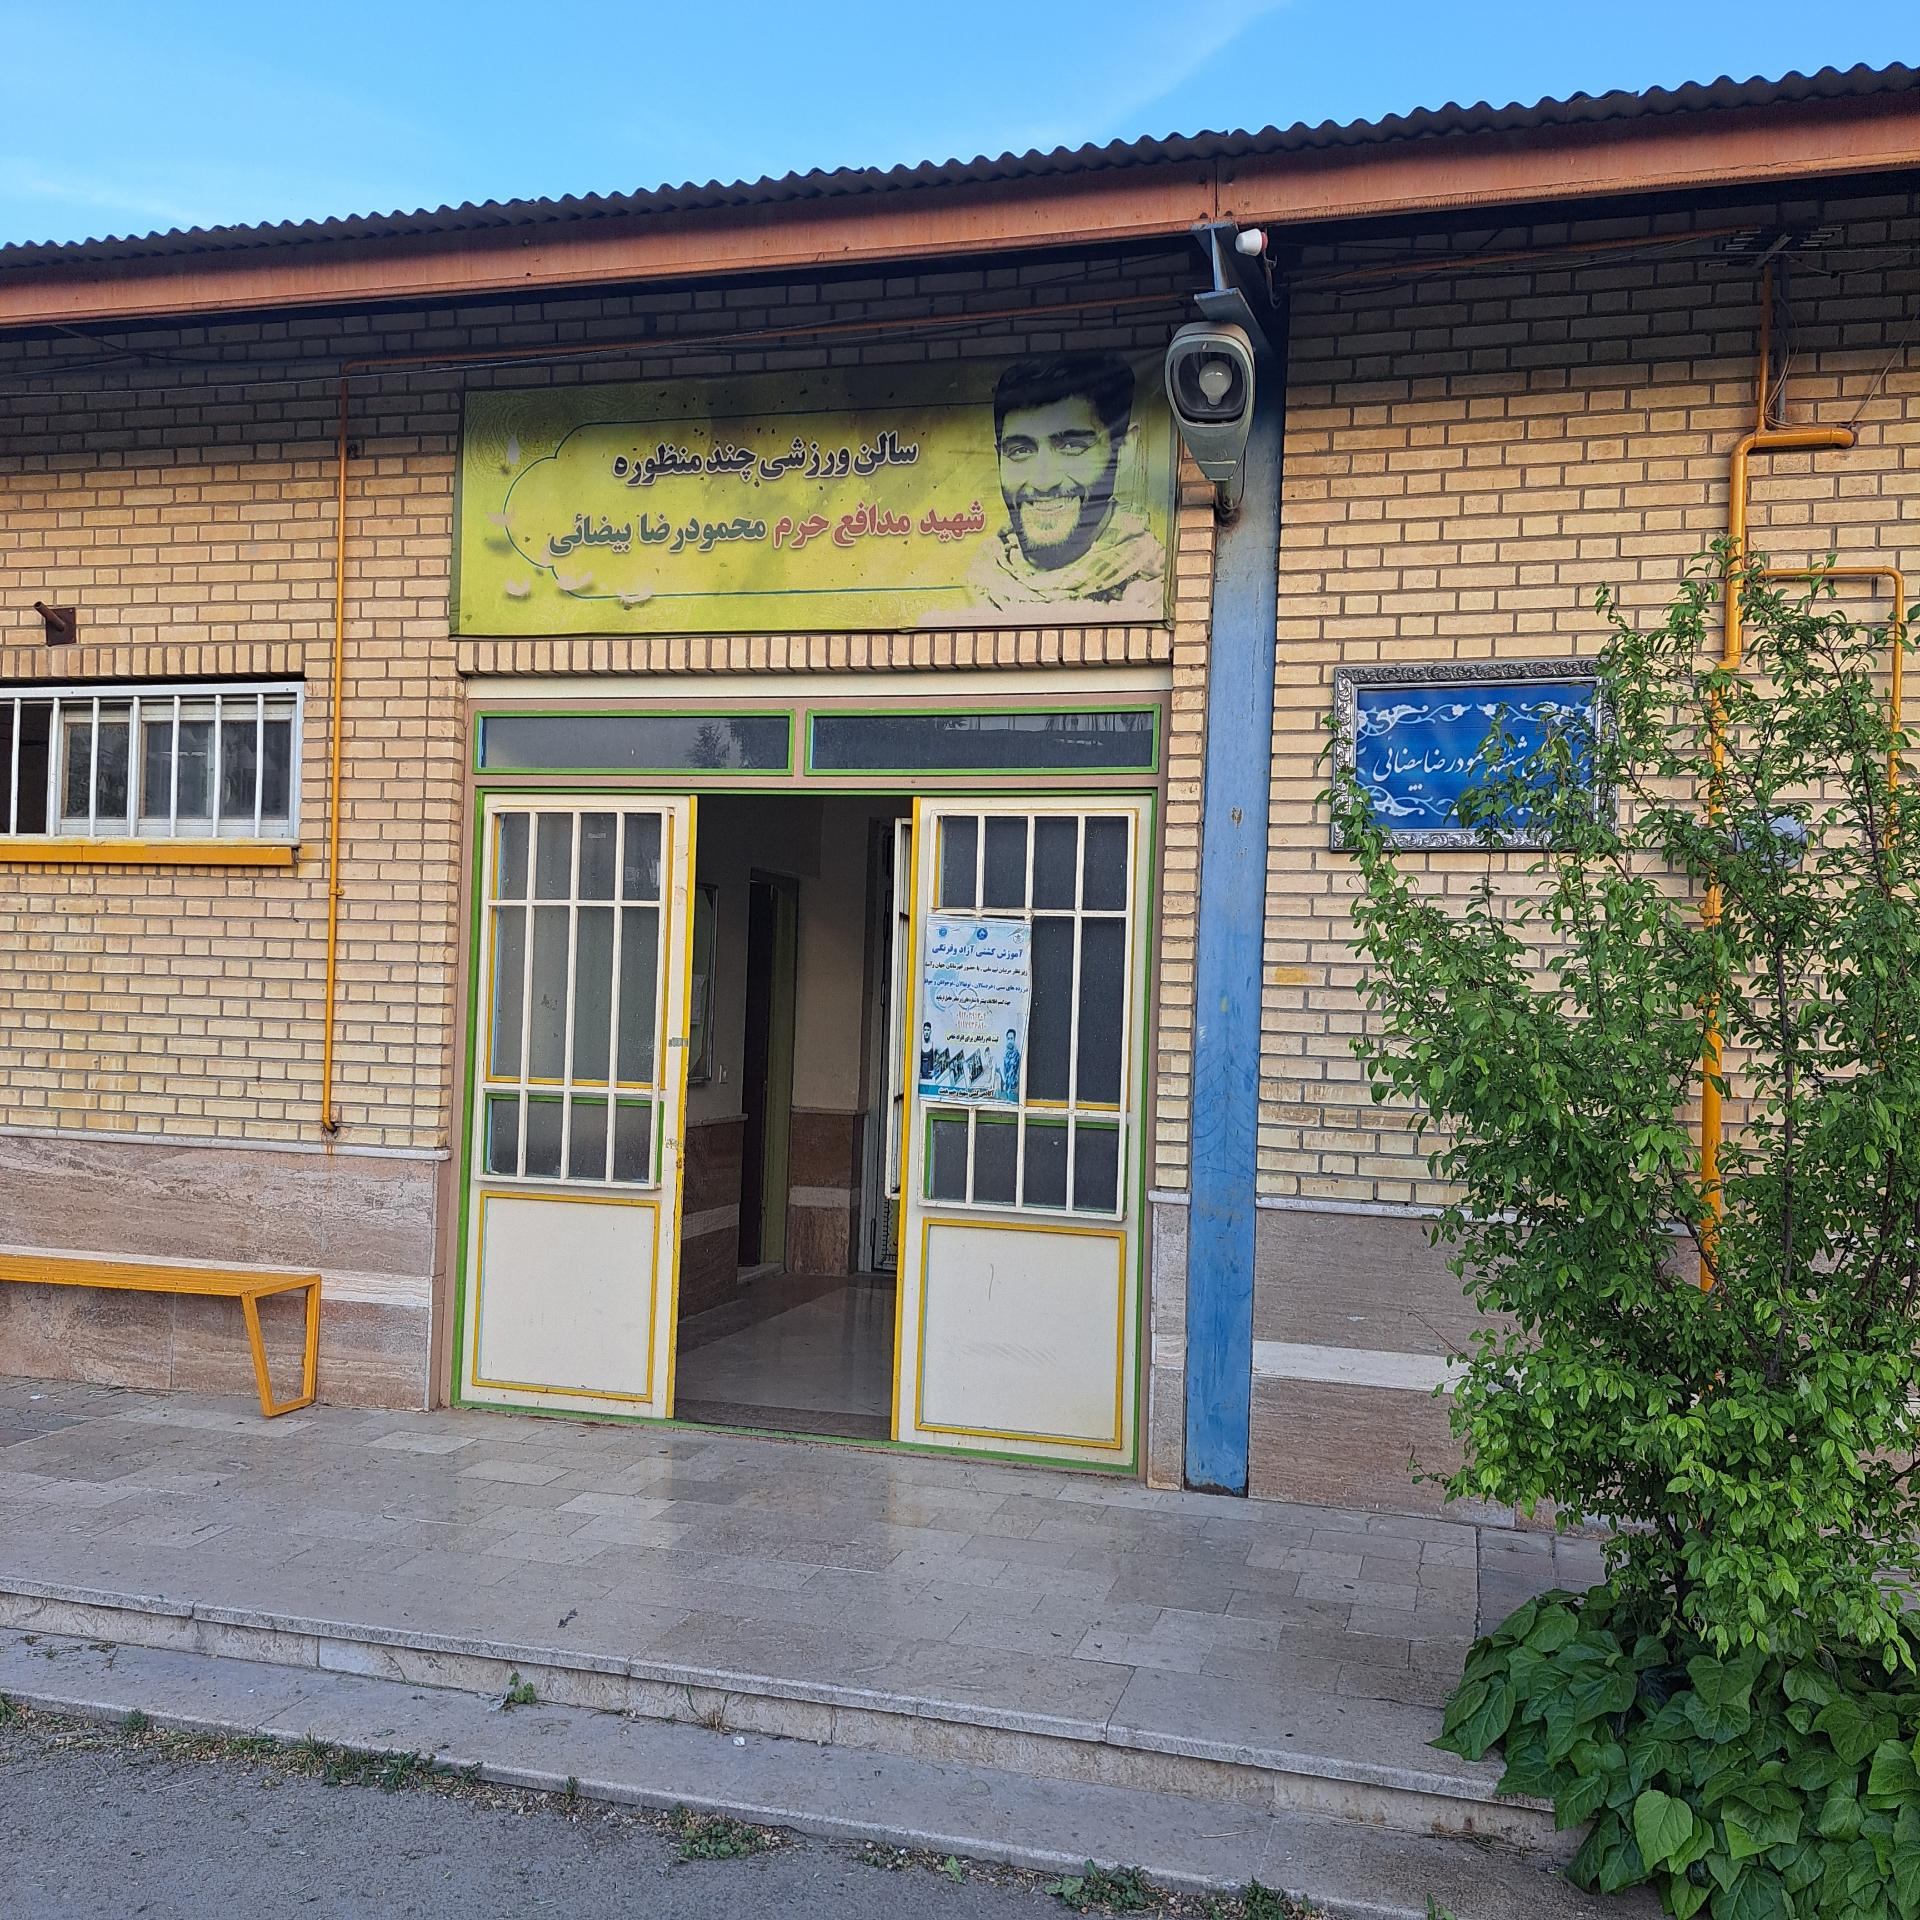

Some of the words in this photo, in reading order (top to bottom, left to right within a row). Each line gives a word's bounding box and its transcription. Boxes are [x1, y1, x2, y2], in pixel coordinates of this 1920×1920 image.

[613, 442, 704, 486] منظوره
[705, 441, 757, 483] چند
[759, 437, 852, 480] ورزشی
[854, 432, 919, 476] سالن
[548, 513, 632, 556] بیضائی
[773, 516, 830, 548] حرم
[832, 502, 911, 547] مدافع
[919, 501, 986, 540] شهید
[959, 945, 975, 956] آزاد
[976, 947, 996, 957] کشتی
[997, 948, 1023, 960] آموزش
